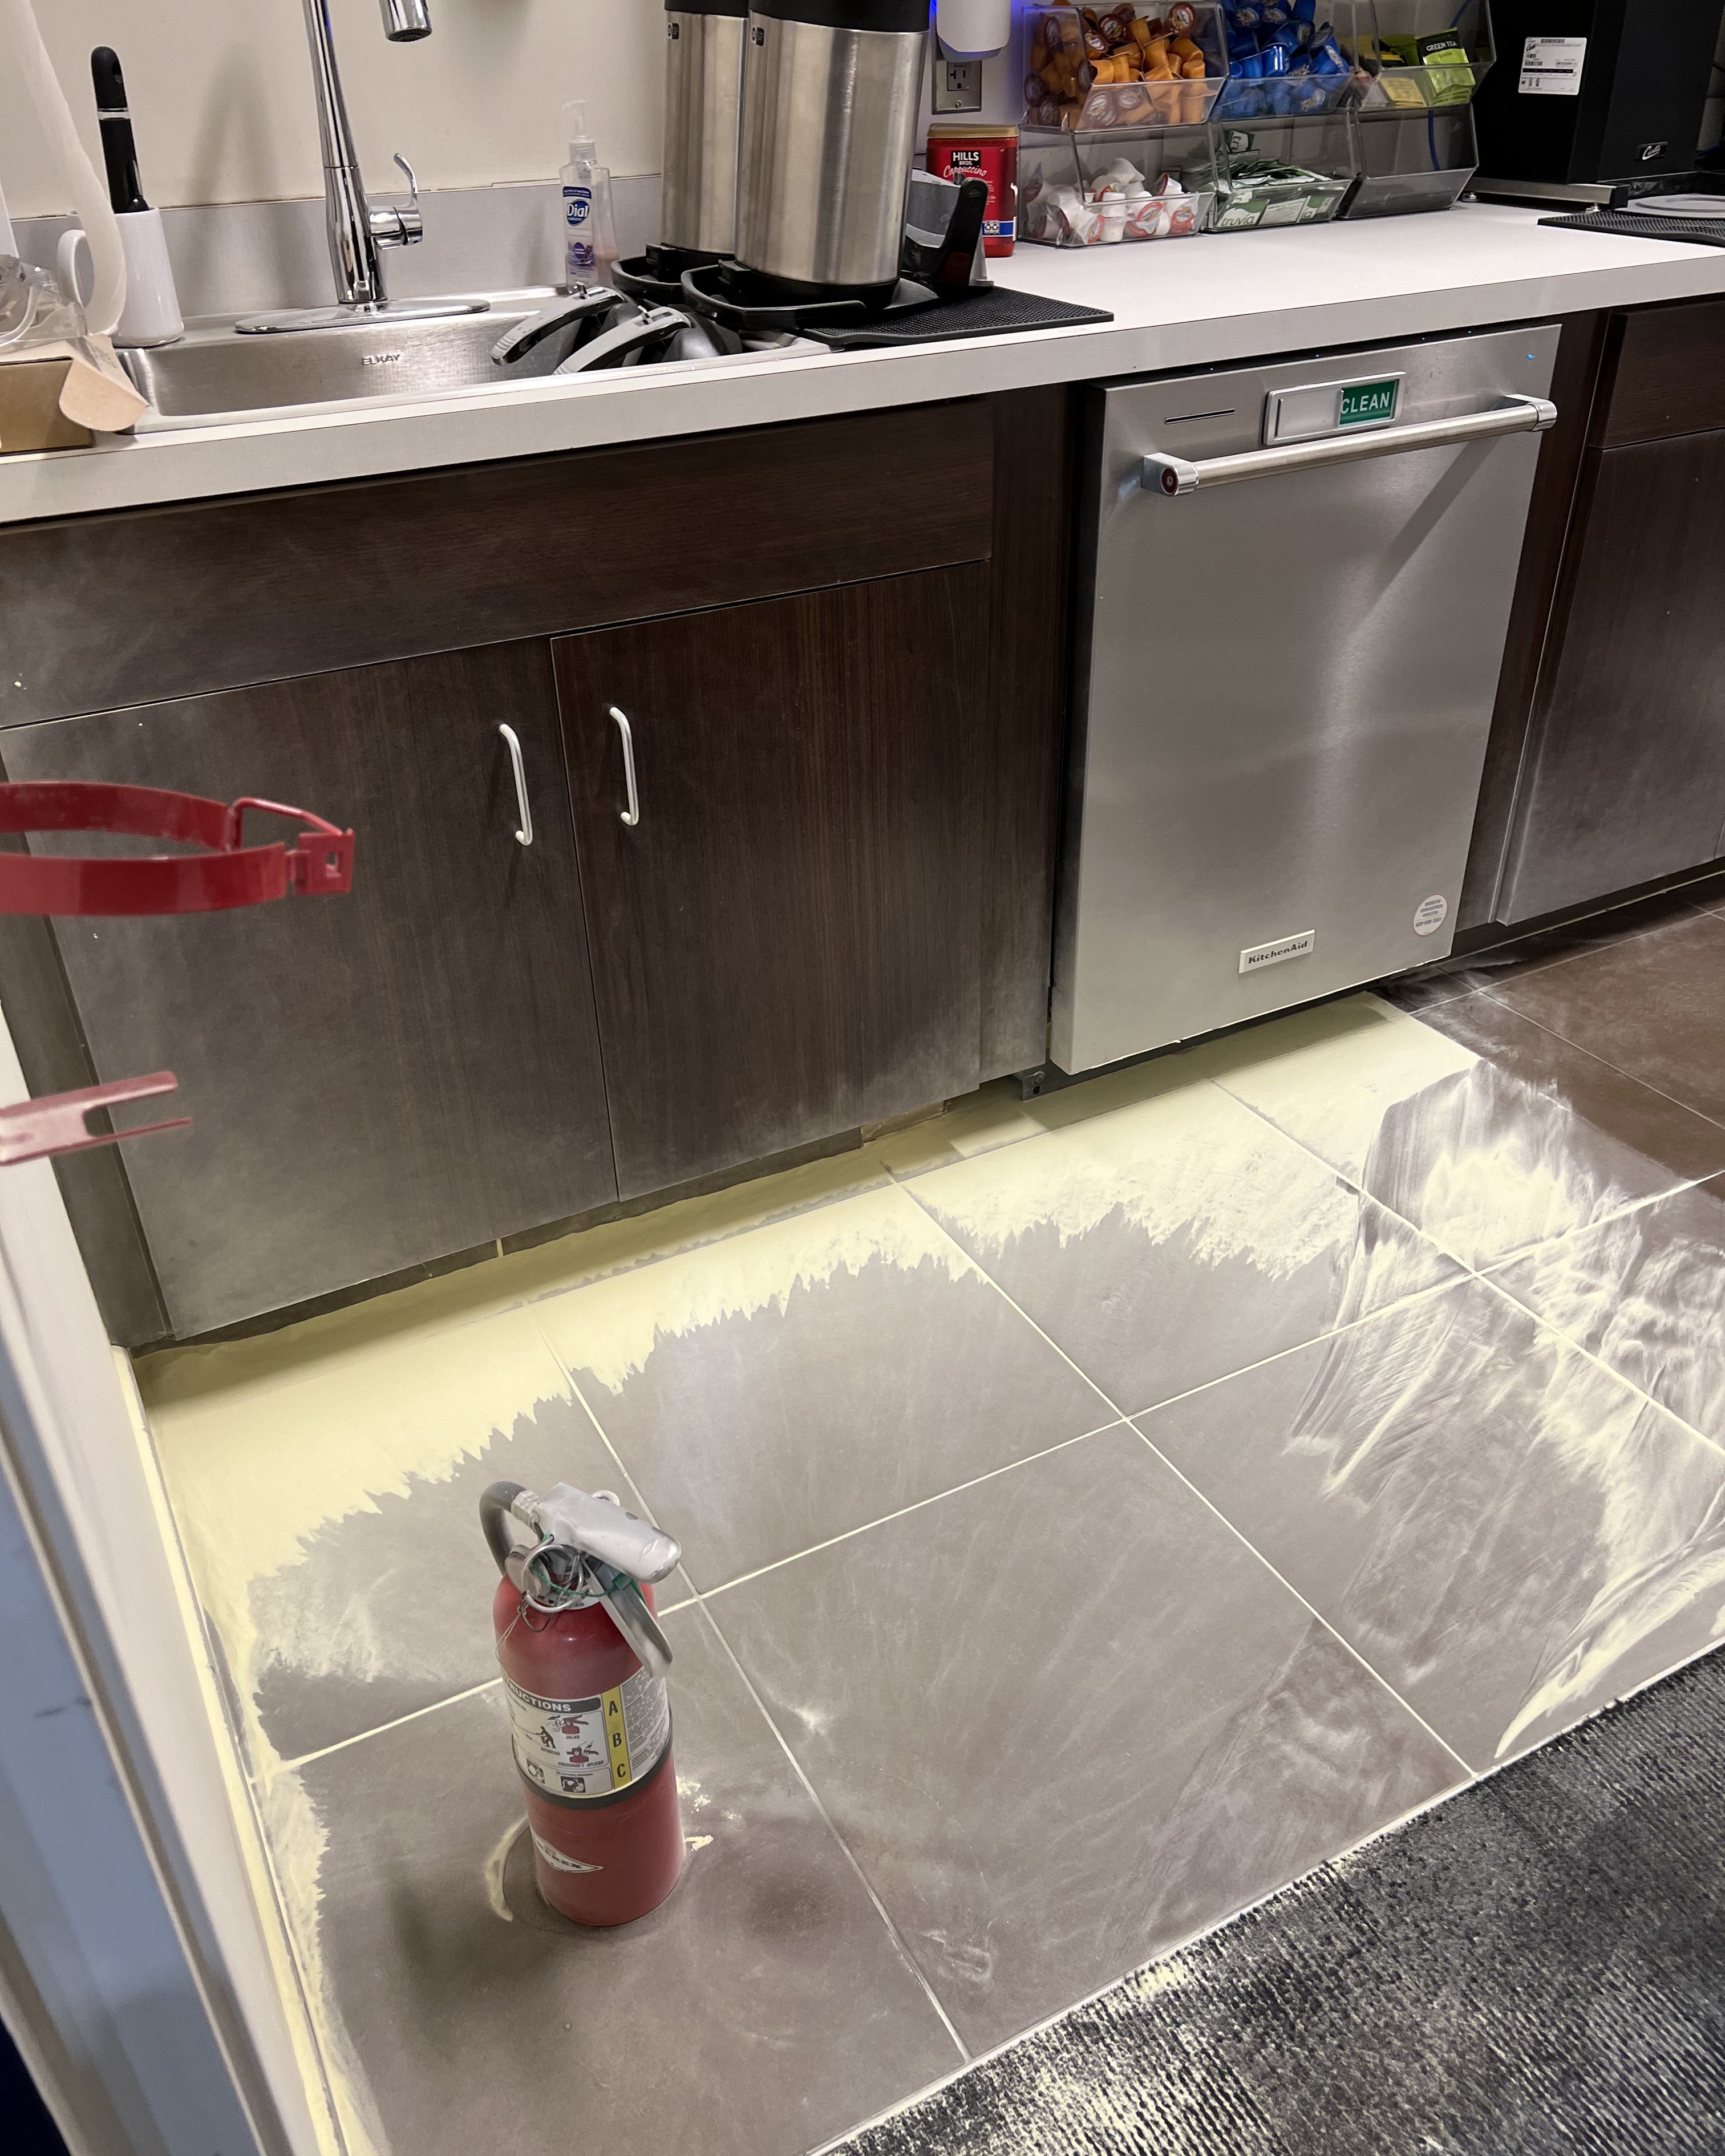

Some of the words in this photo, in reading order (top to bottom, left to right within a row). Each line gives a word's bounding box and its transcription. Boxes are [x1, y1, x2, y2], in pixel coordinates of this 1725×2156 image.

[953, 152, 979, 161] HILLS
[943, 165, 987, 178] Cappuccino
[567, 203, 589, 218] Dial
[362, 354, 400, 365] ELKAY
[1341, 392, 1390, 415] CLEAN
[1248, 941, 1308, 964] KitchenAid
[609, 1700, 618, 1716] A
[612, 1732, 622, 1748] B
[617, 1763, 626, 1778] C
